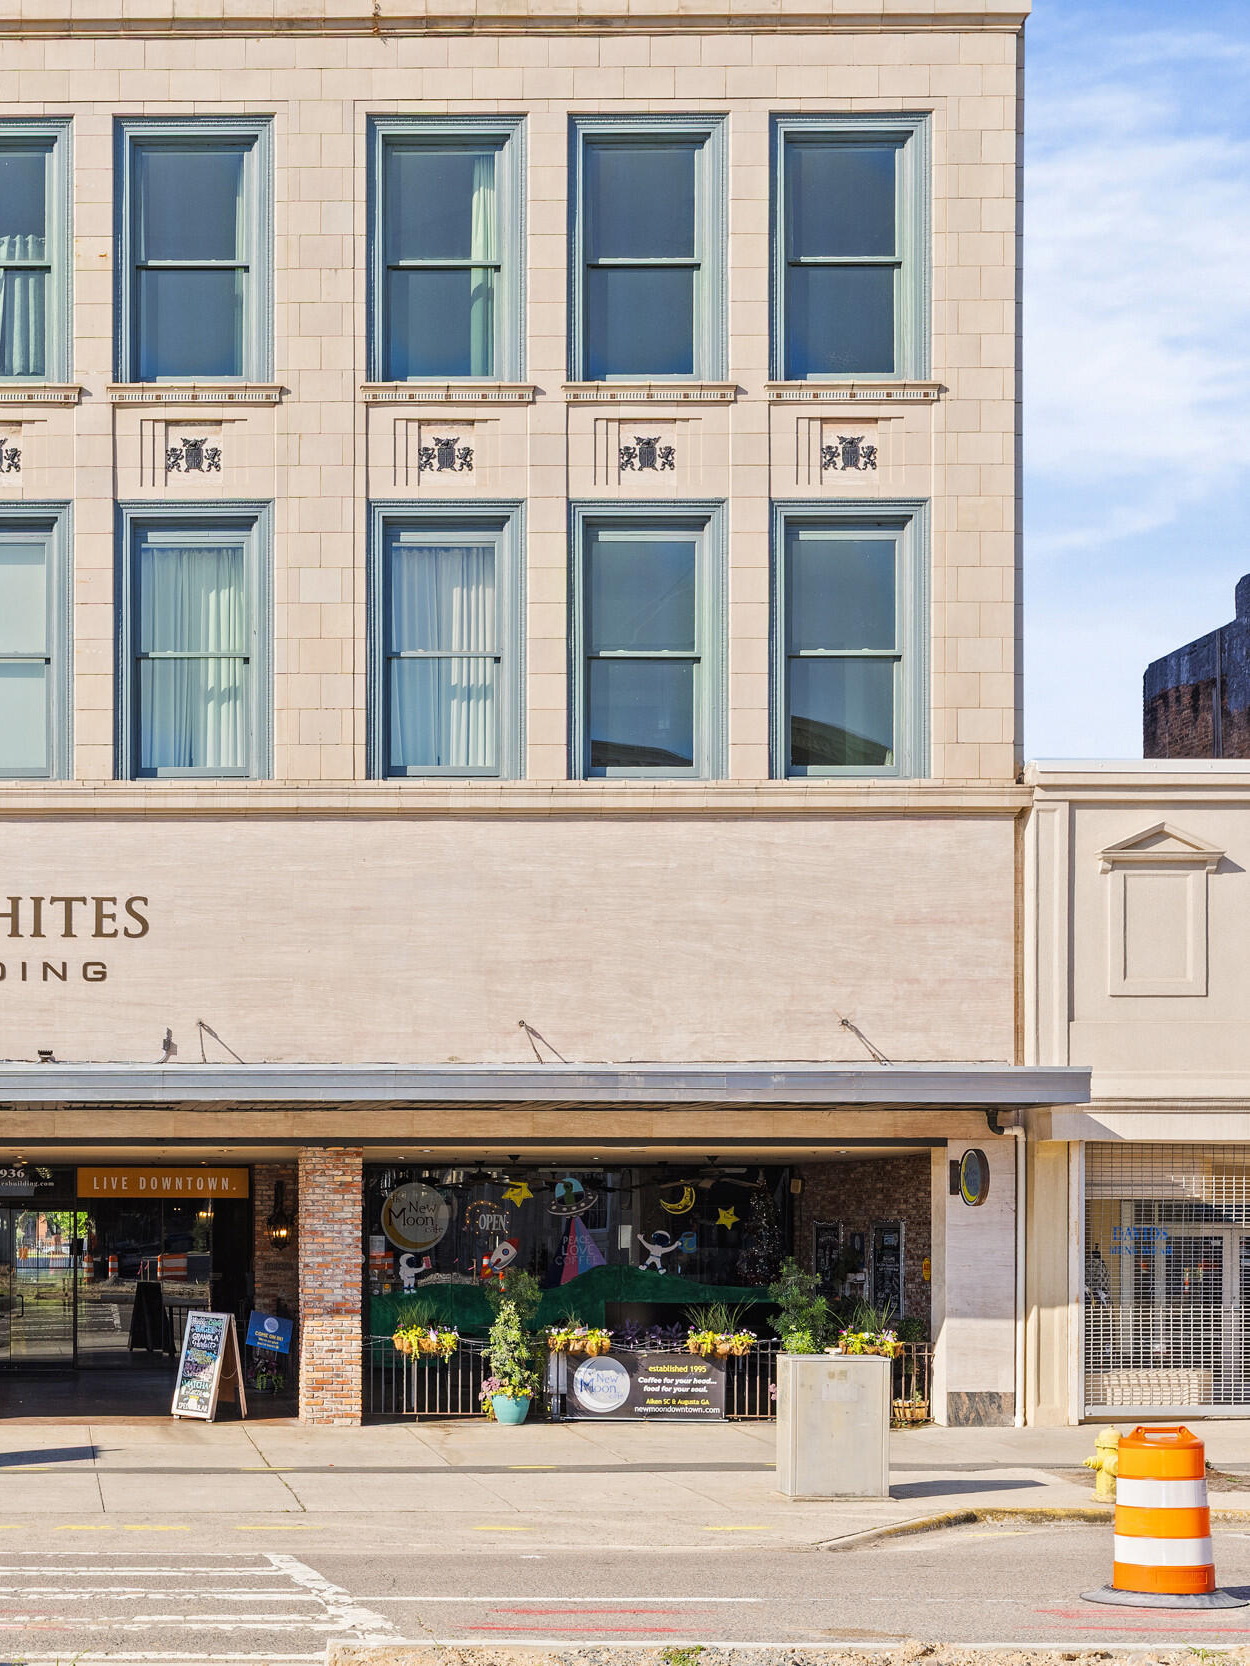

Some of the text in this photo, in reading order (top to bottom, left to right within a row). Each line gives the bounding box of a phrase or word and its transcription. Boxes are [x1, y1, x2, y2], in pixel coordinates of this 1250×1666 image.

[0, 1168, 25, 1178] 936
[93, 1176, 237, 1191] LIVE DOWNTOWN.
[409, 1201, 437, 1214] New
[388, 1207, 435, 1227] Moon
[478, 1213, 507, 1231] OPEN
[562, 1236, 591, 1245] PEACE
[561, 1245, 595, 1256] LOVE
[554, 1256, 599, 1266] COFFEE
[192, 1333, 219, 1342] GRANOLA
[648, 1365, 707, 1373] established 1995
[596, 1373, 619, 1383] New
[638, 1376, 662, 1384] Coffee
[675, 1378, 692, 1386] your
[580, 1377, 617, 1393] Moon
[634, 1406, 721, 1414] newmoondowntown.com
